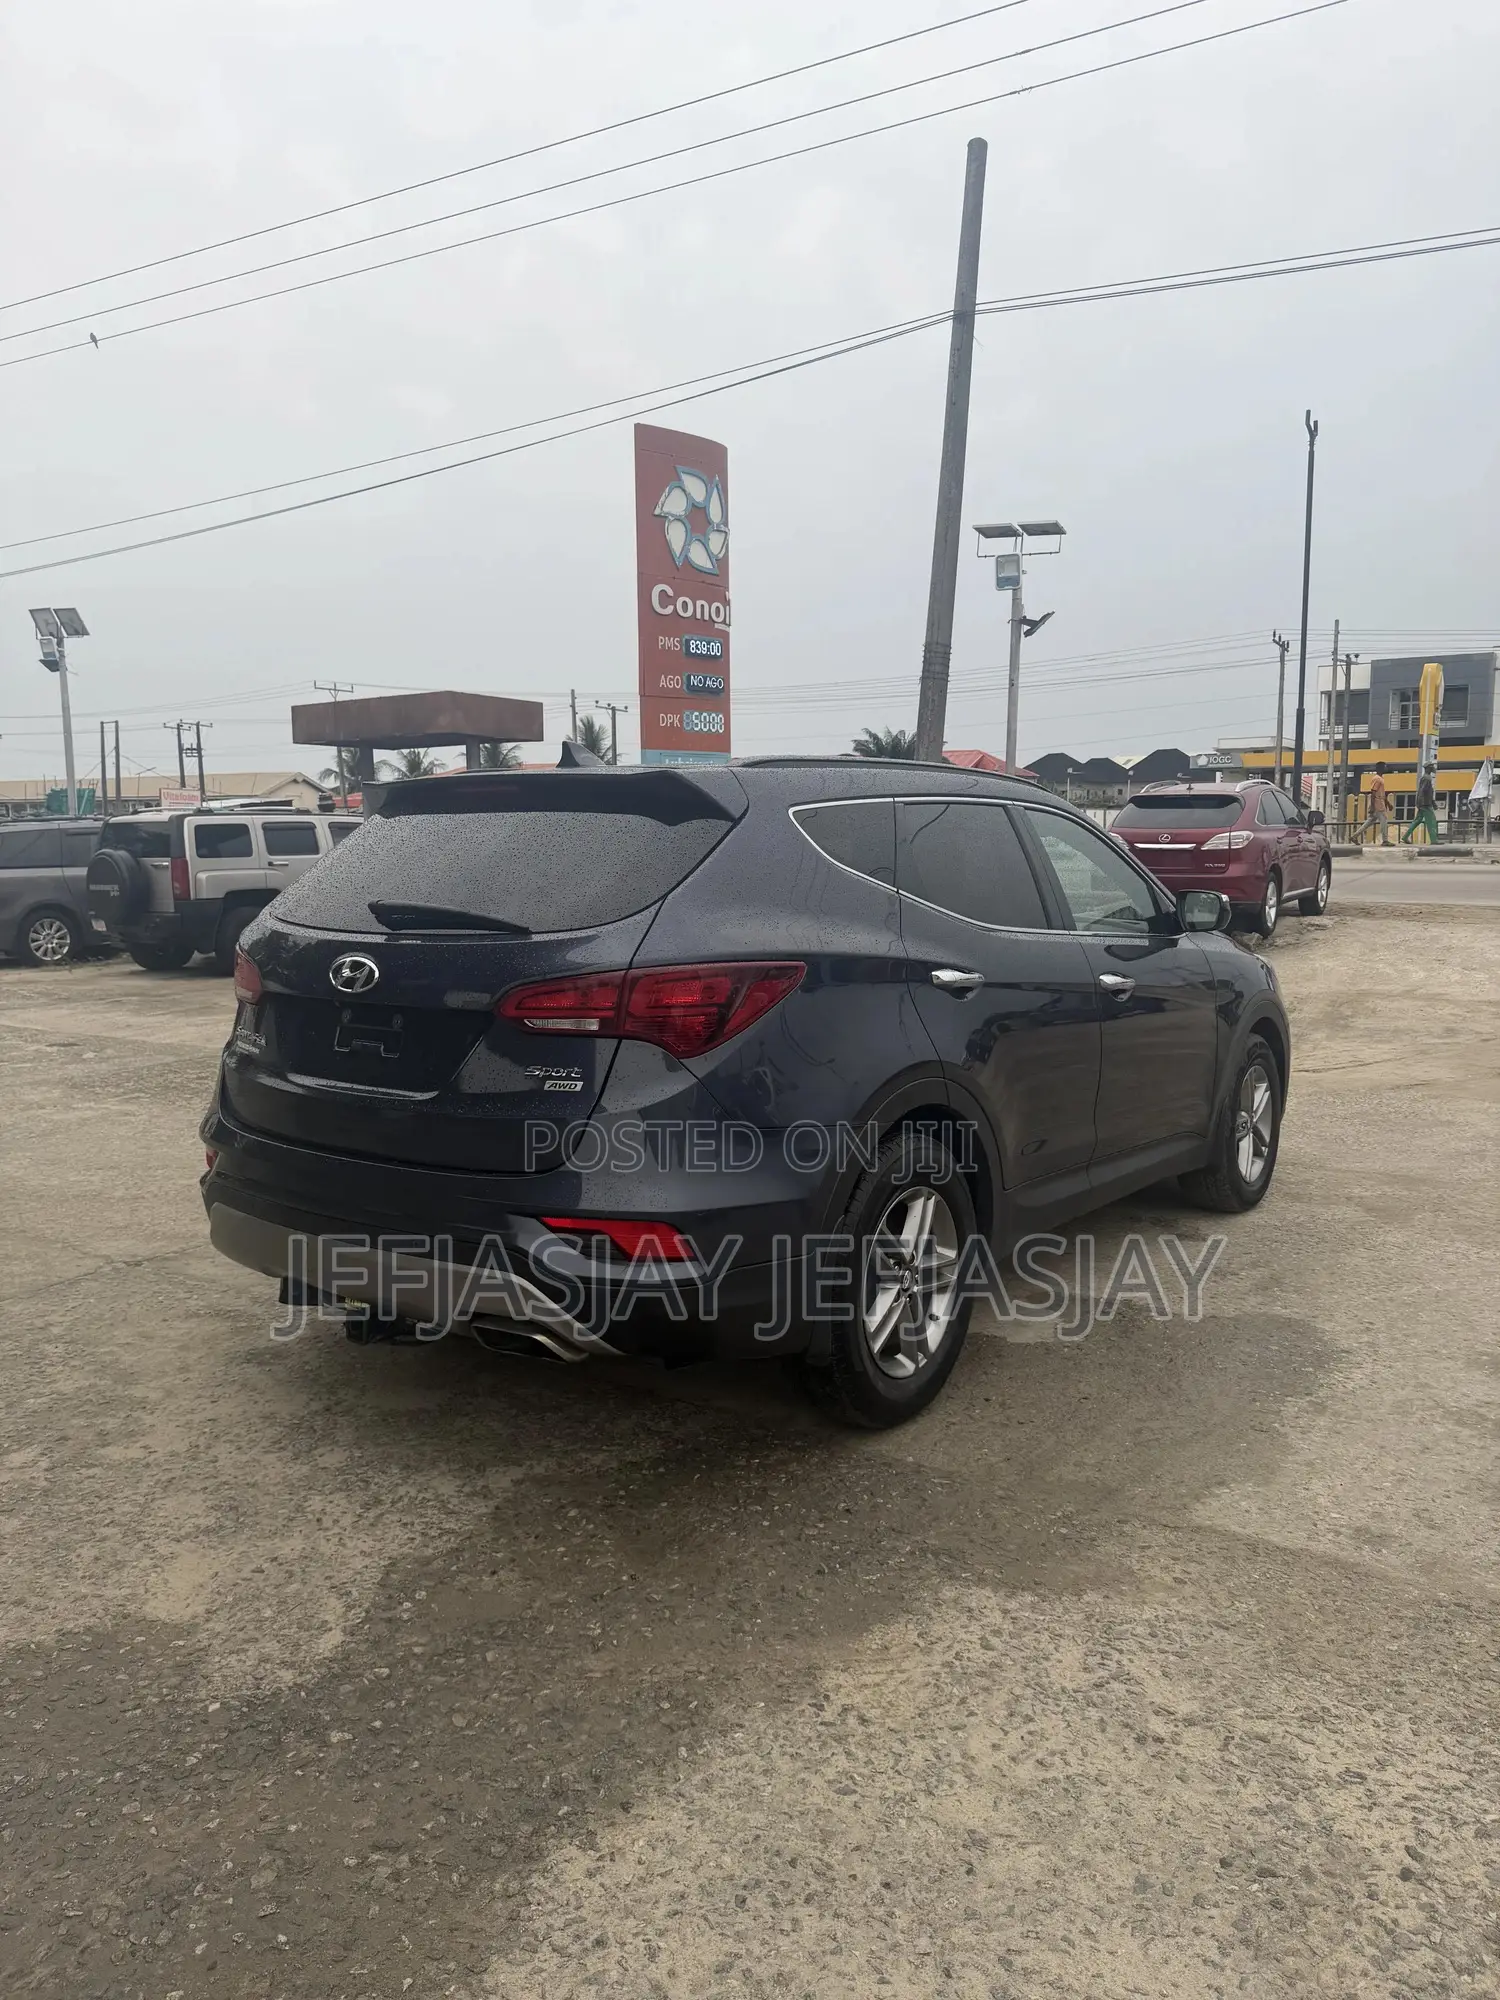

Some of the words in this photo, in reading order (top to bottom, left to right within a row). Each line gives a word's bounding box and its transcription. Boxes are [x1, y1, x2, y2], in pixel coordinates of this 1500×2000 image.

[658, 636, 681, 651] PMS
[690, 640, 722, 656] 839:00
[659, 674, 682, 689] AGO
[690, 675, 704, 687] NO
[705, 677, 724, 689] AGO
[659, 713, 681, 728] DPK
[524, 1066, 583, 1078] Sport
[547, 1082, 578, 1090] AWD
